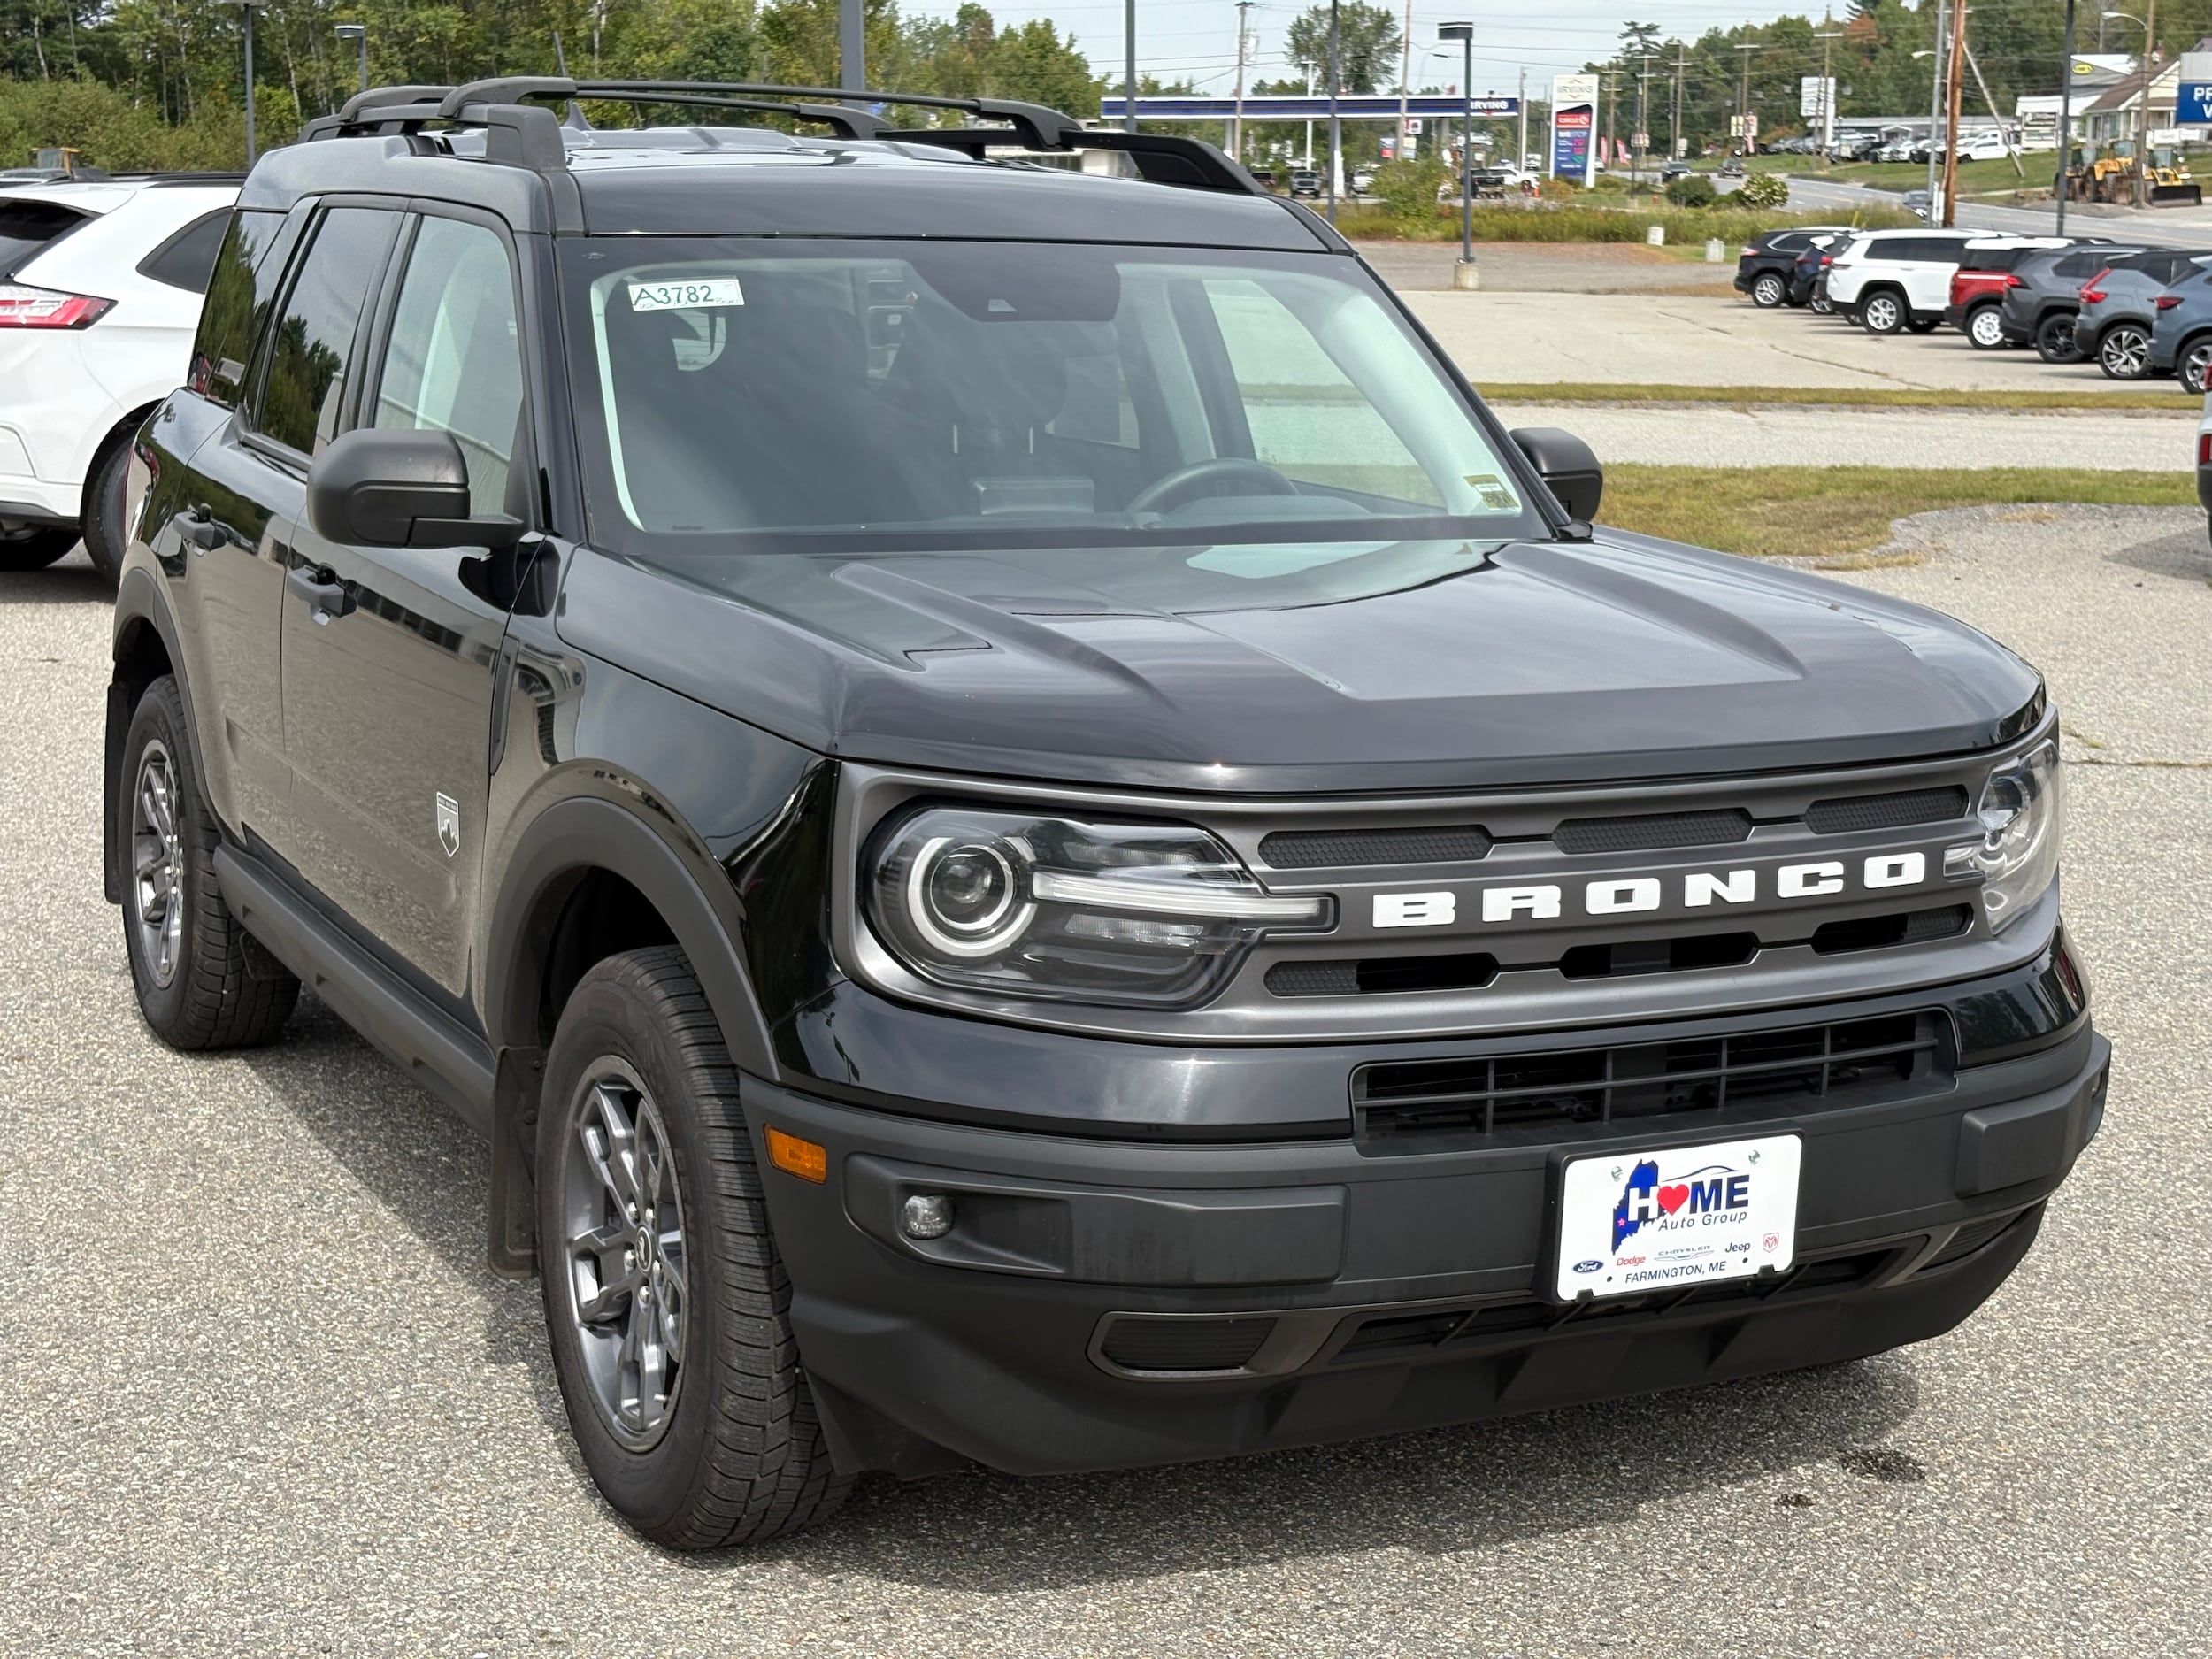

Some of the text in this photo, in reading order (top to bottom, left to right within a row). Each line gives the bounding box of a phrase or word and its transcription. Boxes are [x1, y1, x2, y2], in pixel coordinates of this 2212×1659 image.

[1470, 100, 1509, 110] IRVING
[1372, 851, 1925, 928] BRONCO
[1658, 1210, 1747, 1232] Auto Group
[1725, 1241, 1751, 1254] Jeep
[1616, 1255, 1646, 1267] Dodge
[1625, 1261, 1727, 1284] FARMINGTON, ME
